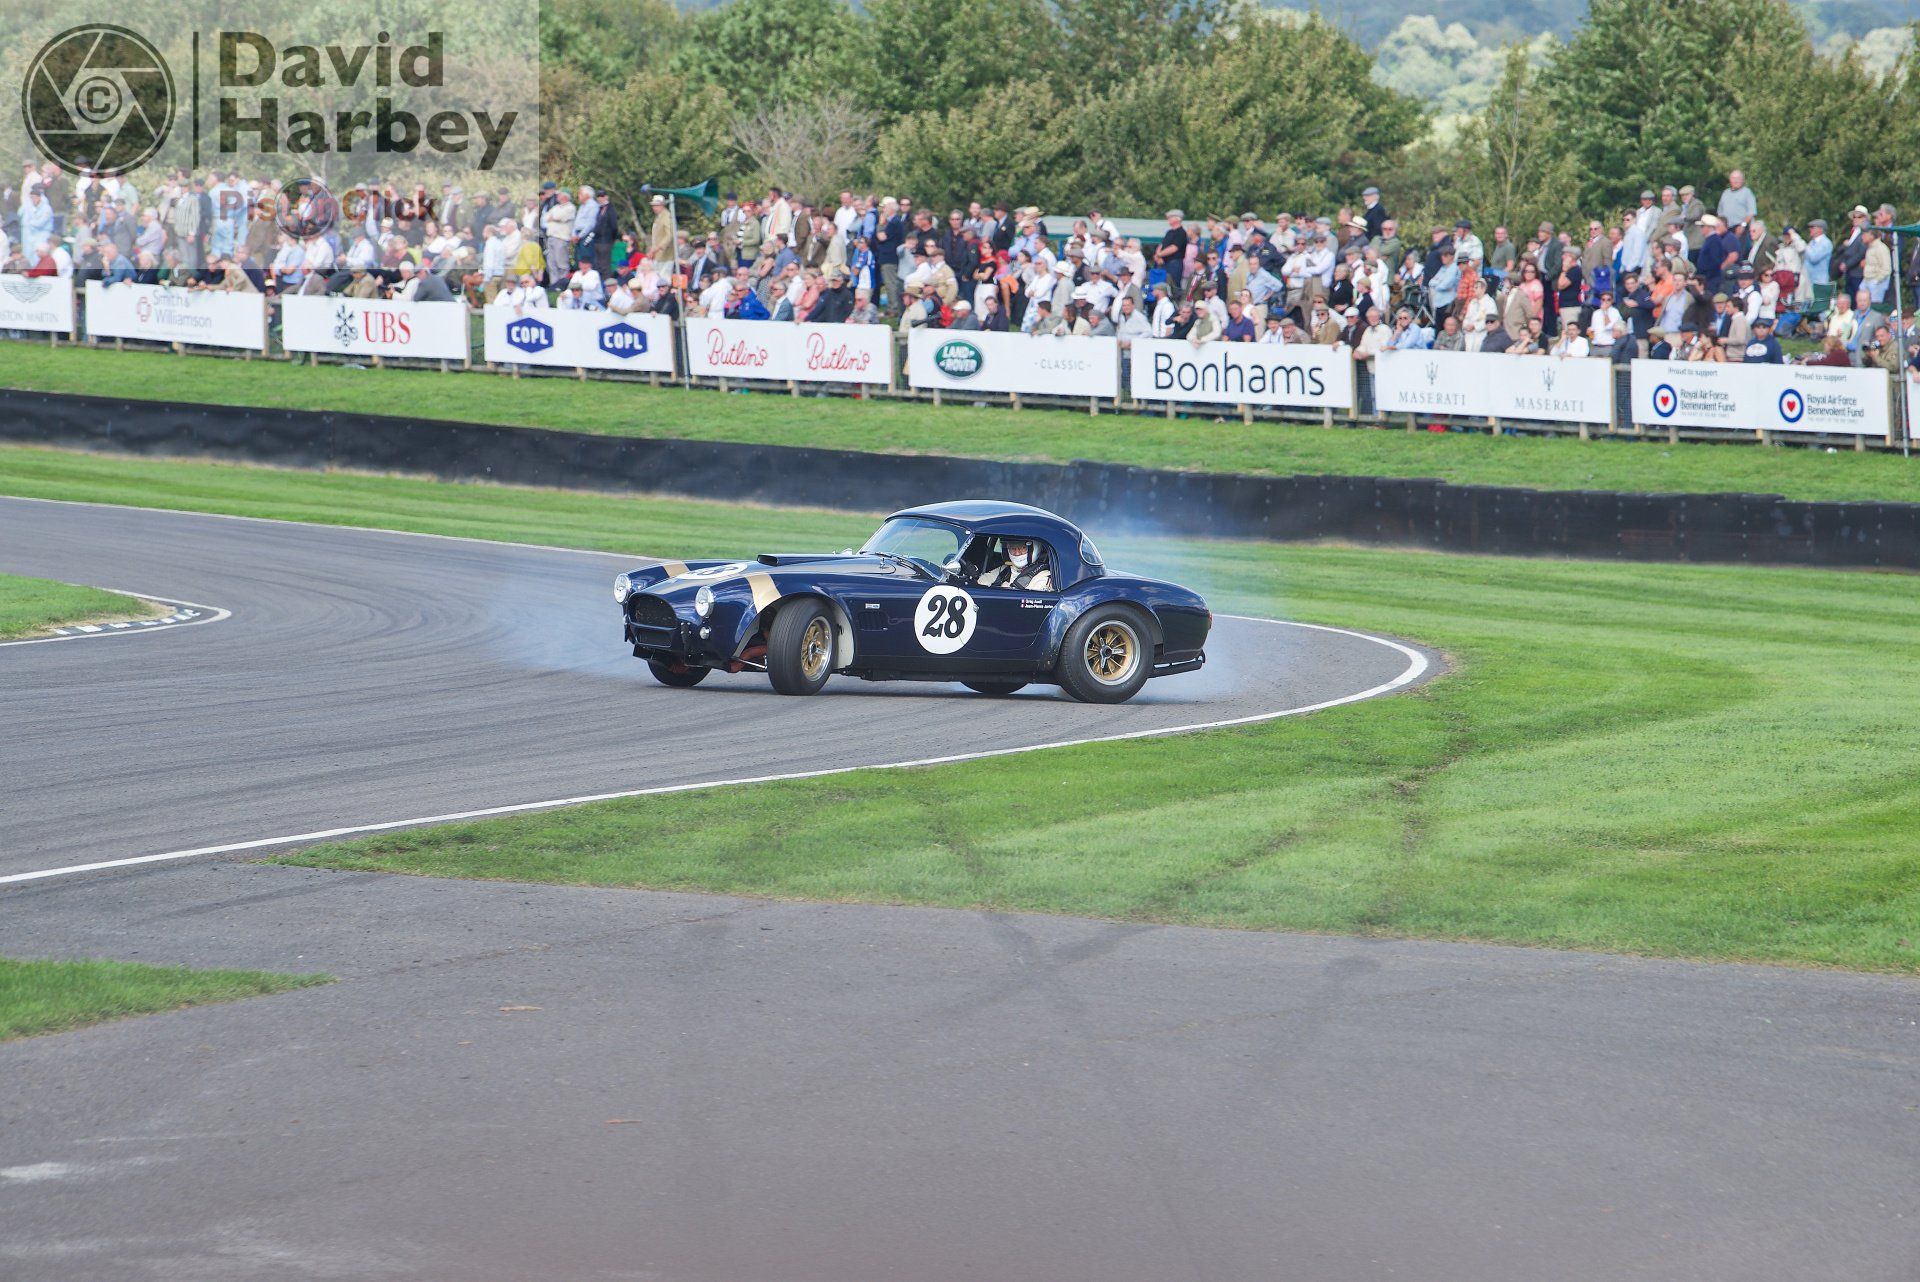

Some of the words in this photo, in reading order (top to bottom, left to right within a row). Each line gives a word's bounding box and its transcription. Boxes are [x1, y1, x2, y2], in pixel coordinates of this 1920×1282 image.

[153, 289, 183, 306] Smith
[154, 308, 213, 329] Williamson
[363, 311, 411, 344] UBS
[510, 325, 549, 346] COPL
[603, 331, 643, 351] COPL
[707, 328, 768, 367] Butlin's
[806, 332, 871, 371] Butlin's
[1040, 358, 1085, 371] CLASSIC
[1154, 351, 1325, 396] Bonhams
[1695, 369, 1718, 377] support
[1824, 374, 1847, 382] support
[1399, 391, 1466, 406] MASERATI
[1680, 389, 1698, 400] Royal
[1709, 390, 1728, 400] Force
[1807, 394, 1826, 405] Royal
[1828, 395, 1836, 404] Air
[1838, 395, 1857, 406] Force
[1515, 397, 1584, 413] MASERATI
[1680, 400, 1717, 411] Benevolent
[1718, 402, 1736, 412] Fund
[1807, 405, 1845, 416] Benevolent
[1847, 407, 1864, 418] Fund
[922, 595, 968, 639] 28
